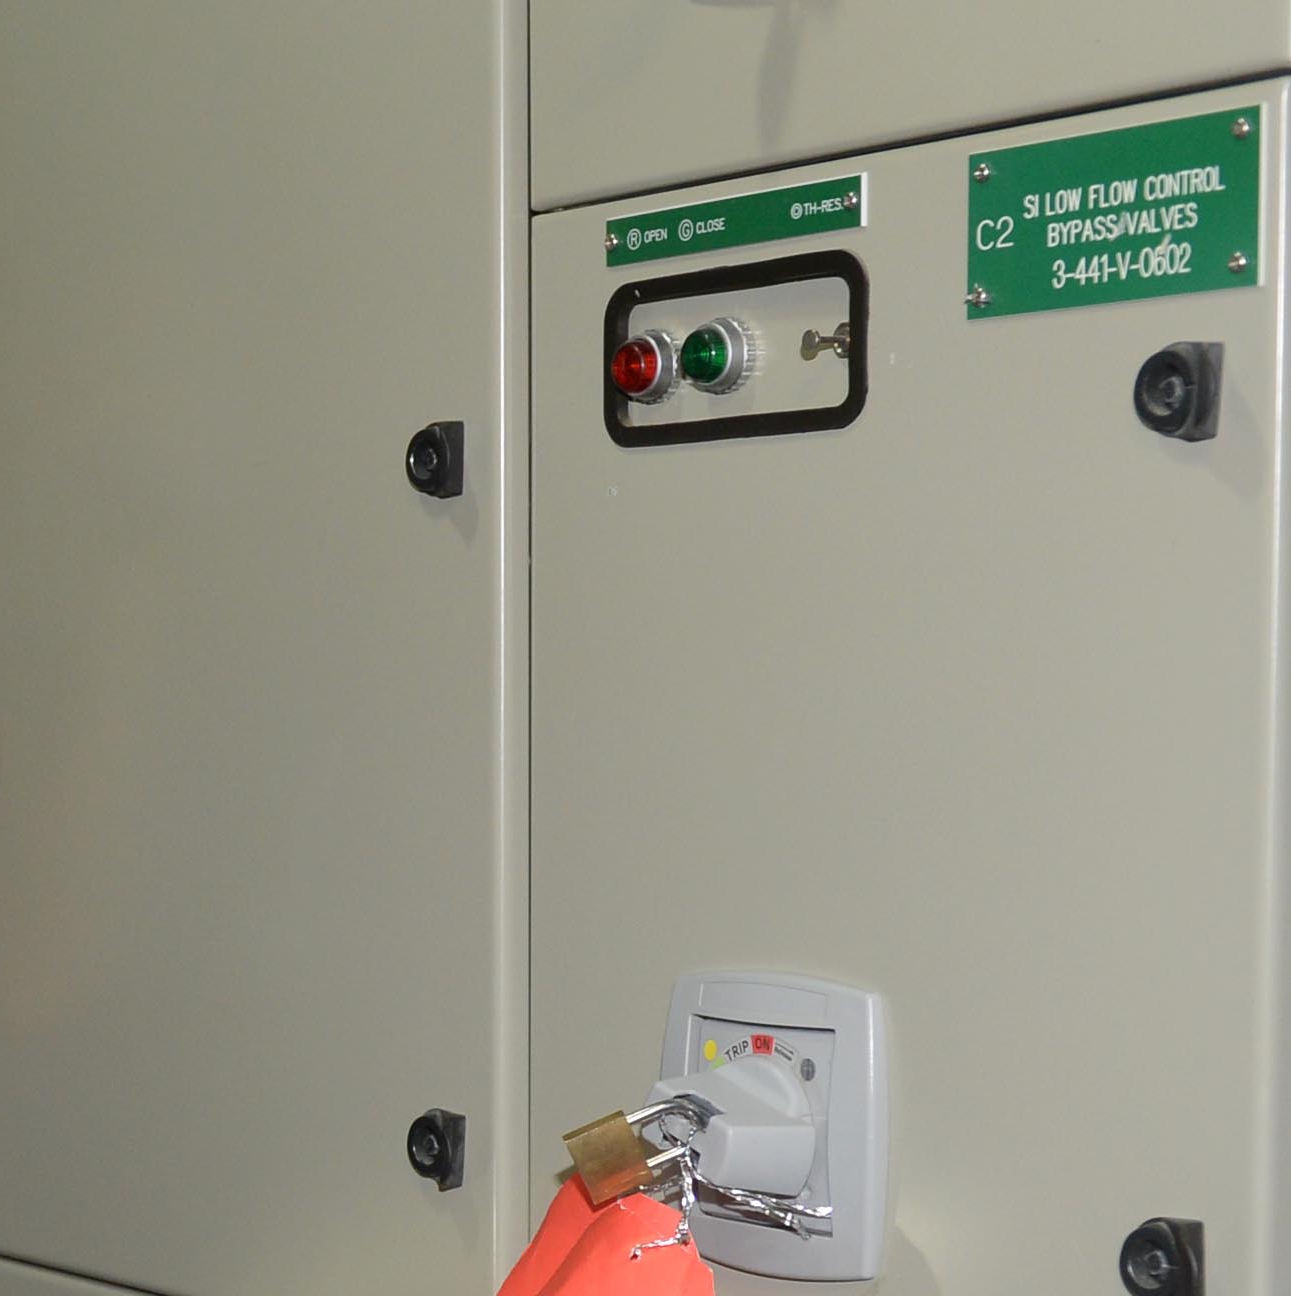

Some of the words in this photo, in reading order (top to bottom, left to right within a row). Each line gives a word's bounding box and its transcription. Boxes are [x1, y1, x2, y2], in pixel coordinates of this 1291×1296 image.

[1023, 194, 1039, 219] SI
[1045, 187, 1082, 216] LOW
[1088, 179, 1137, 210] FLOW
[1144, 165, 1225, 201] CONTROL
[644, 227, 668, 243] OPEN
[696, 217, 726, 234] CLOSE
[976, 215, 1014, 250] C2
[1052, 242, 1192, 289] 3-441-V-0602
[725, 1040, 749, 1061] TRIP
[755, 1038, 770, 1050] ON
